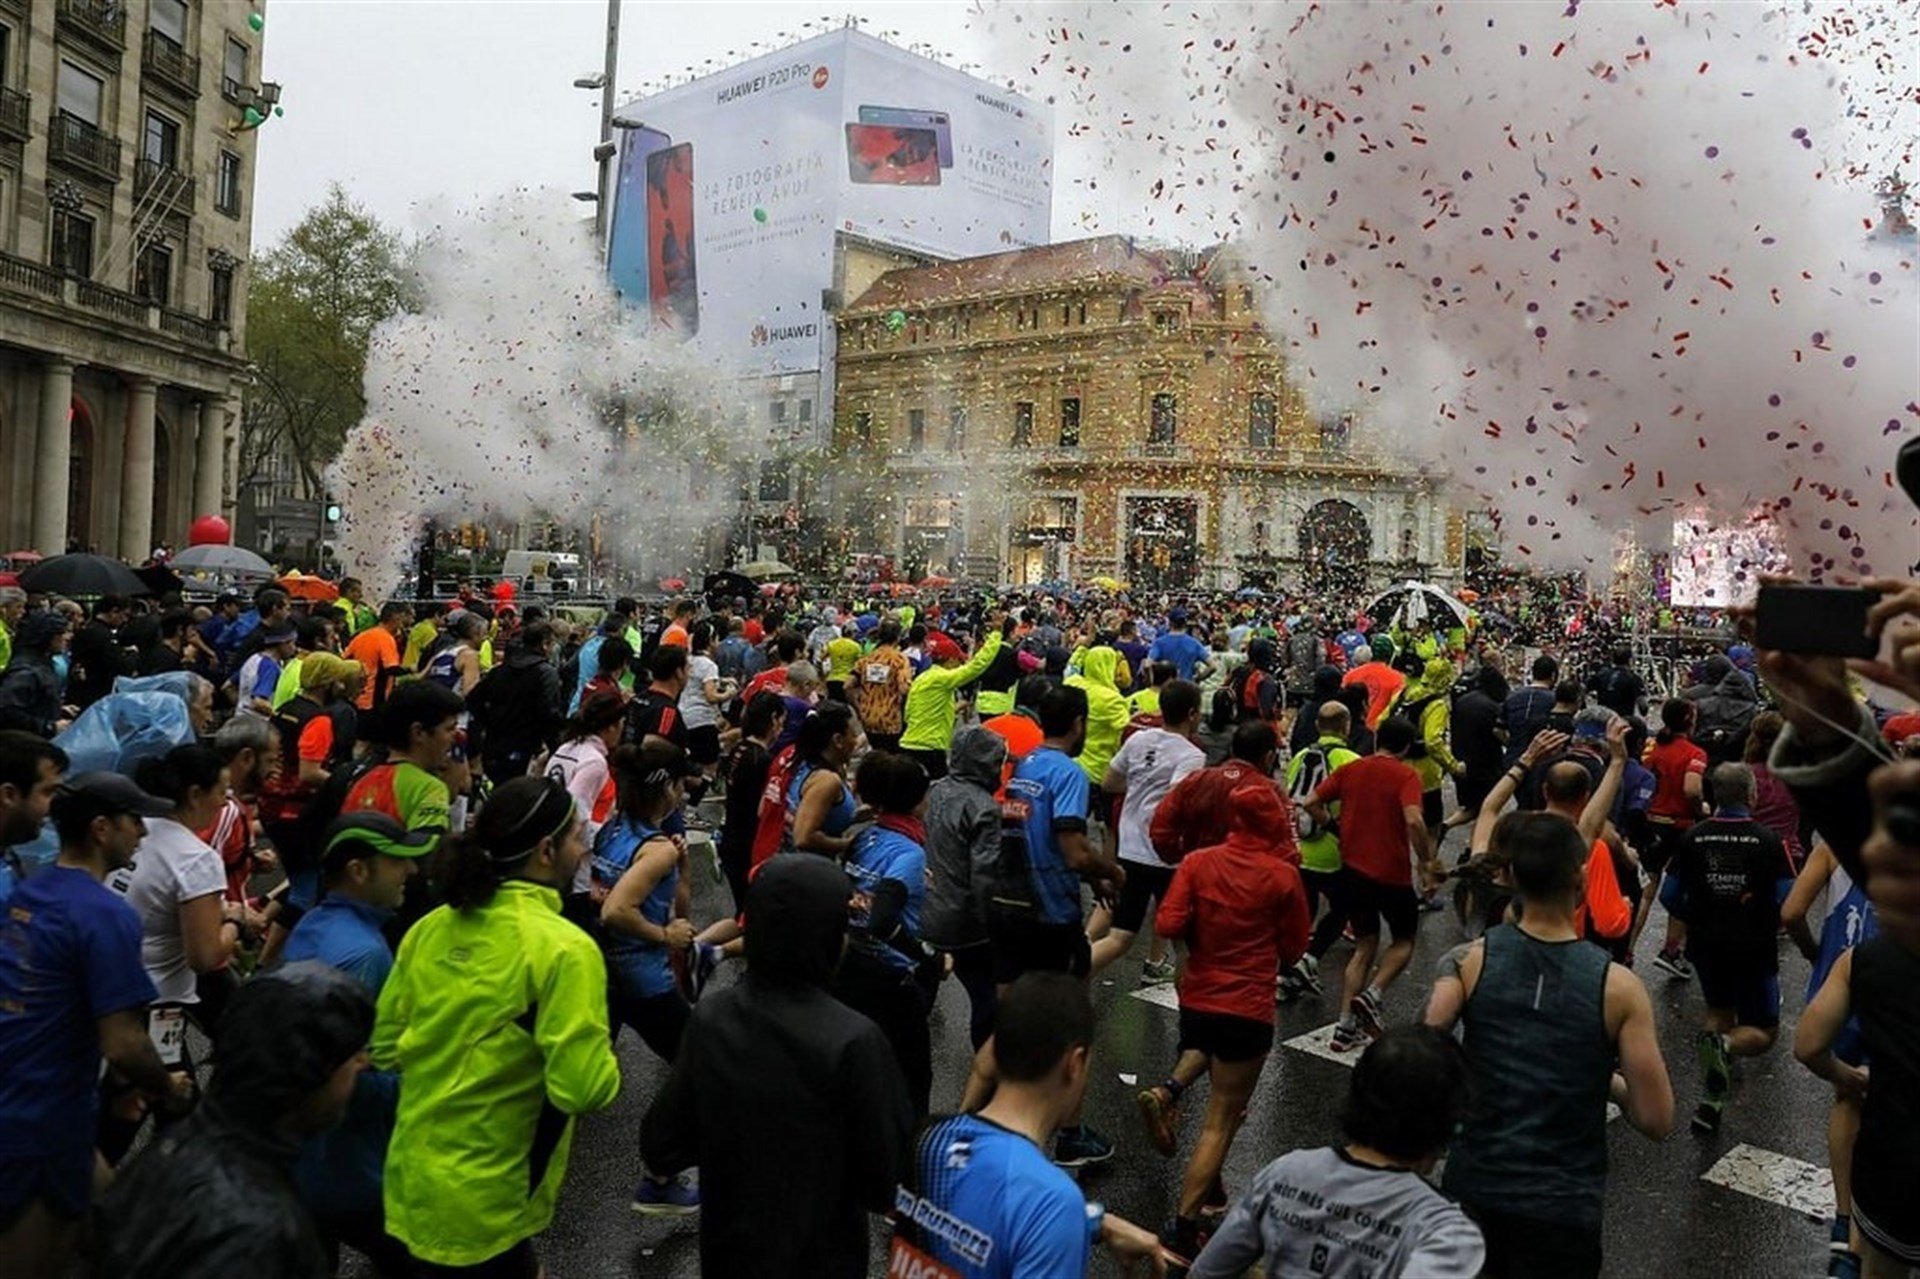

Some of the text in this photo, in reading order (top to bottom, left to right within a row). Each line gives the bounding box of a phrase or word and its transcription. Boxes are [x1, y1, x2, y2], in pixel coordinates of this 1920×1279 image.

[717, 76, 766, 105] HUAWEI
[767, 67, 791, 87] P20
[769, 324, 817, 344] HUAWEI
